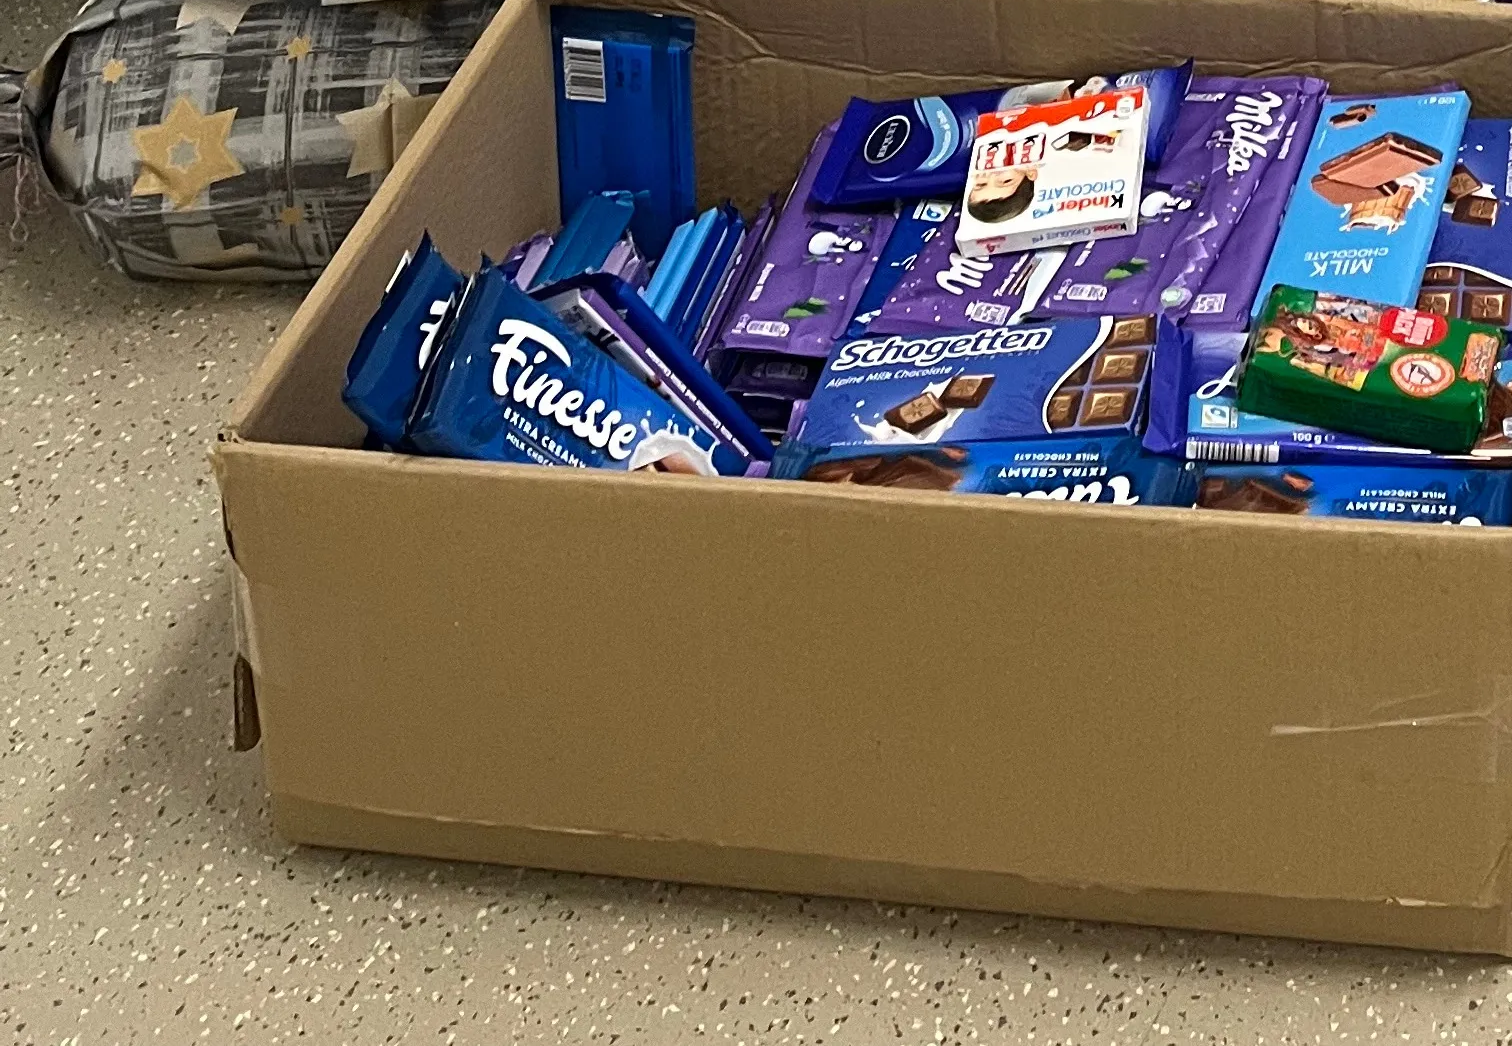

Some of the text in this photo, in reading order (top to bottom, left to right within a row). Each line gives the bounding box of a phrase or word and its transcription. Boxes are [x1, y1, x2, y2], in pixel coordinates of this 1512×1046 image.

[1226, 91, 1283, 177] Milka
[1037, 178, 1126, 203] CHOCOLATE
[1303, 247, 1389, 262] CHOCOLATE
[1309, 257, 1374, 278] MILK
[830, 327, 1053, 372] Schogetten
[490, 318, 637, 460] Finesse
[825, 376, 865, 390] Alpine
[503, 406, 539, 440] EXTRA
[1292, 432, 1312, 442] 100
[997, 466, 1108, 479] EXTRA CREAMY
[1345, 501, 1457, 516] EXTRA CREAMY
